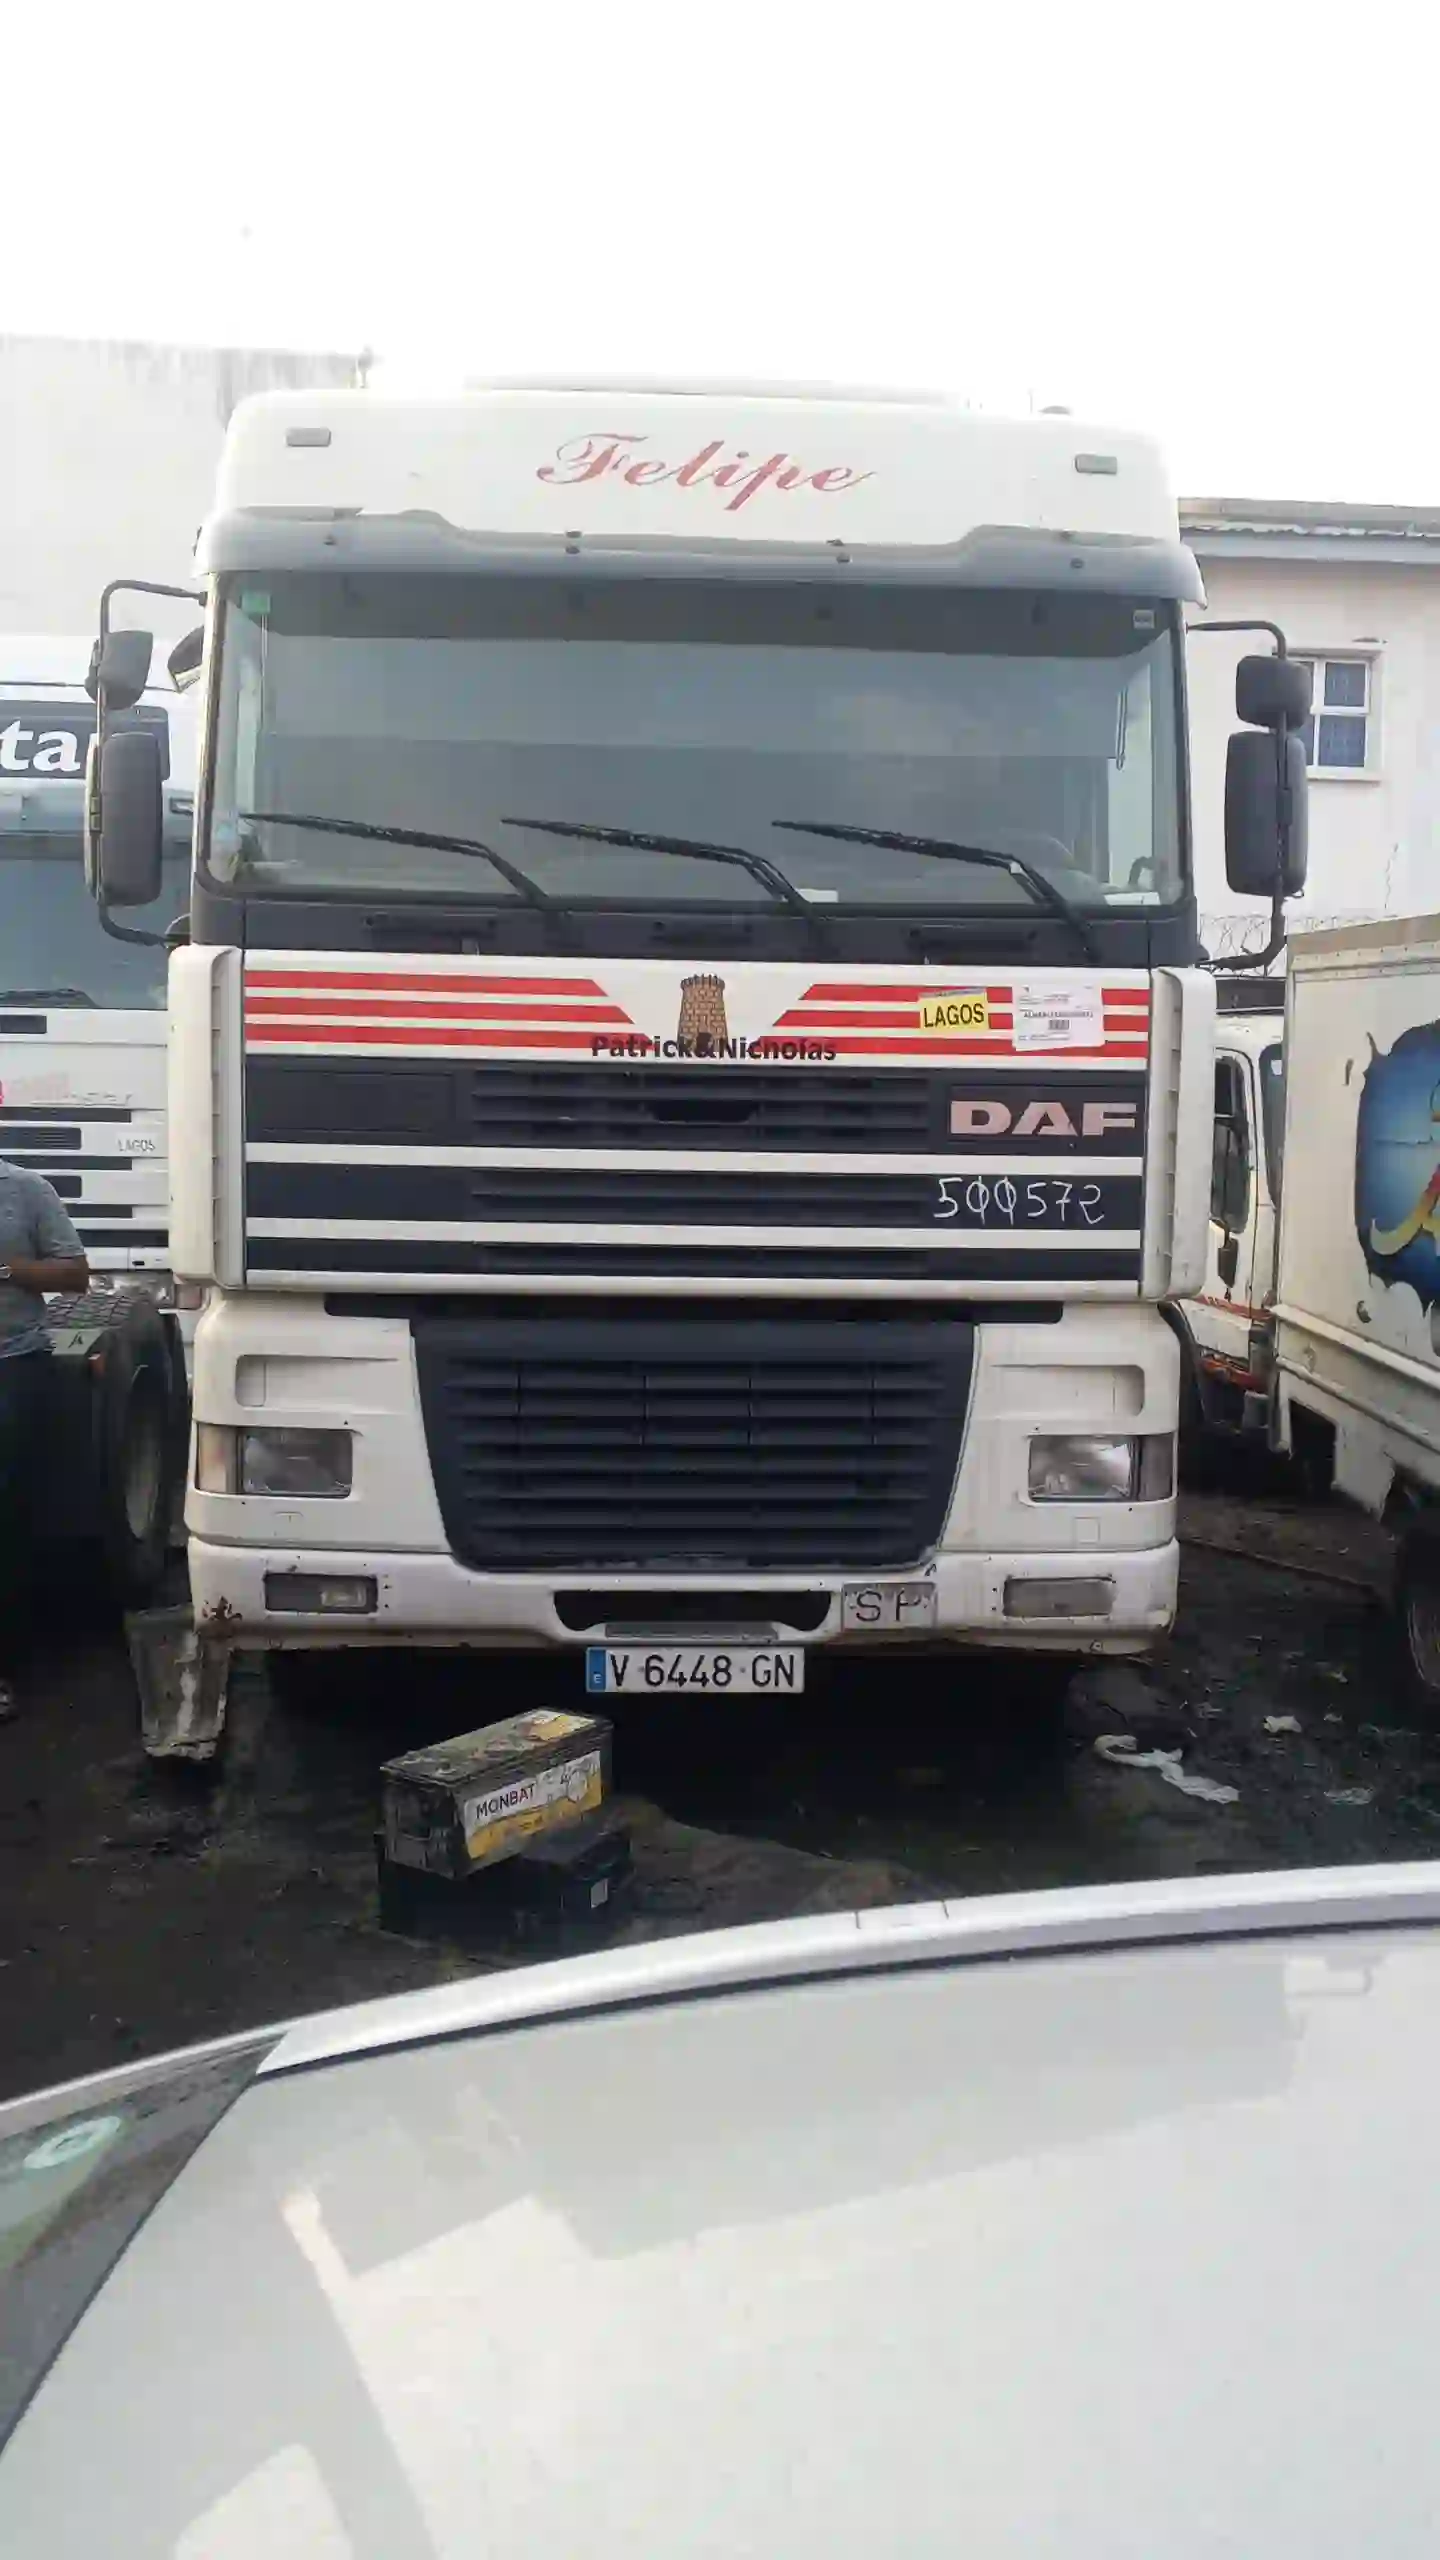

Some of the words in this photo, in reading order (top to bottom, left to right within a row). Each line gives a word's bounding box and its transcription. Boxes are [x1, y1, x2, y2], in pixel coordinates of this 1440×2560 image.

[536, 433, 877, 511] Felipe
[923, 1002, 985, 1028] LAGOS
[950, 1100, 1138, 1137] DAF
[933, 1175, 1105, 1226] 500572
[475, 1783, 536, 1820] MONBAT
